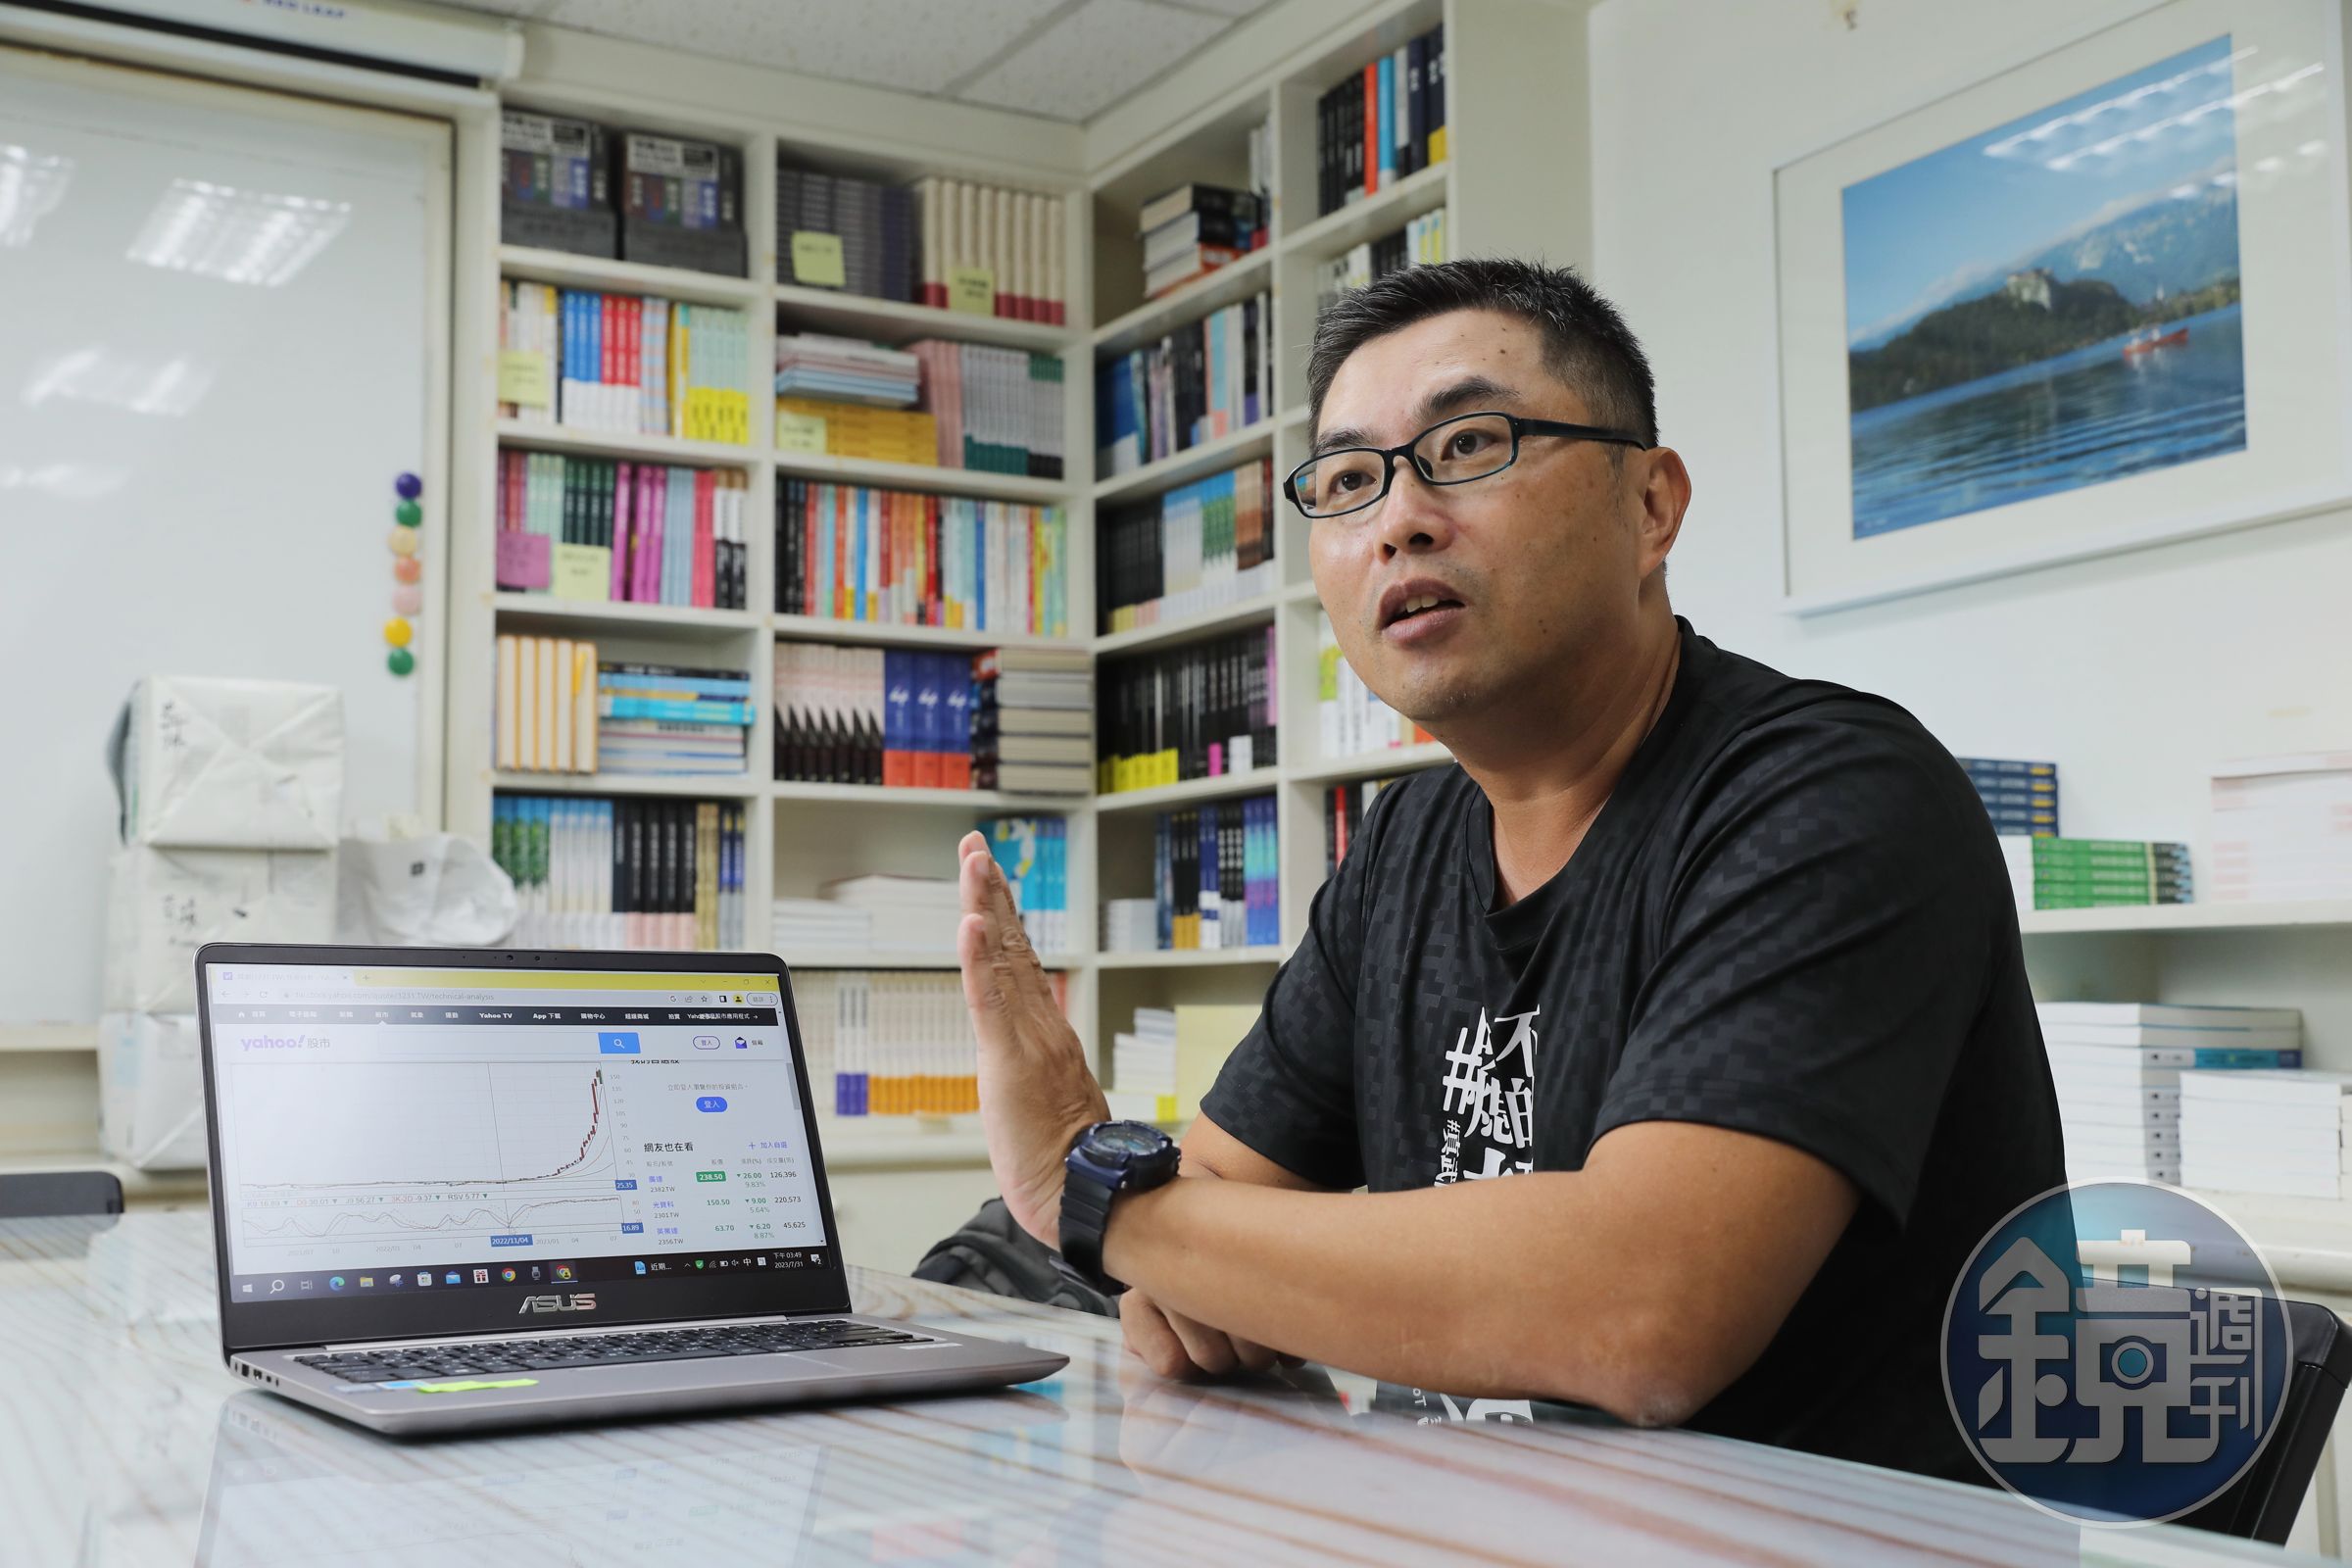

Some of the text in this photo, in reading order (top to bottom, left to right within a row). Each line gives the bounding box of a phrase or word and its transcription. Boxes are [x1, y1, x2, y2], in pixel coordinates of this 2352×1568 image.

[240, 1035, 330, 1052] yahoo! 股市
[704, 1100, 720, 1109] 登入
[644, 1142, 694, 1153] 網友也在看
[743, 1257, 752, 1266] 中
[774, 1259, 804, 1268] 2023/7/31
[518, 1293, 597, 1315] ASUS
